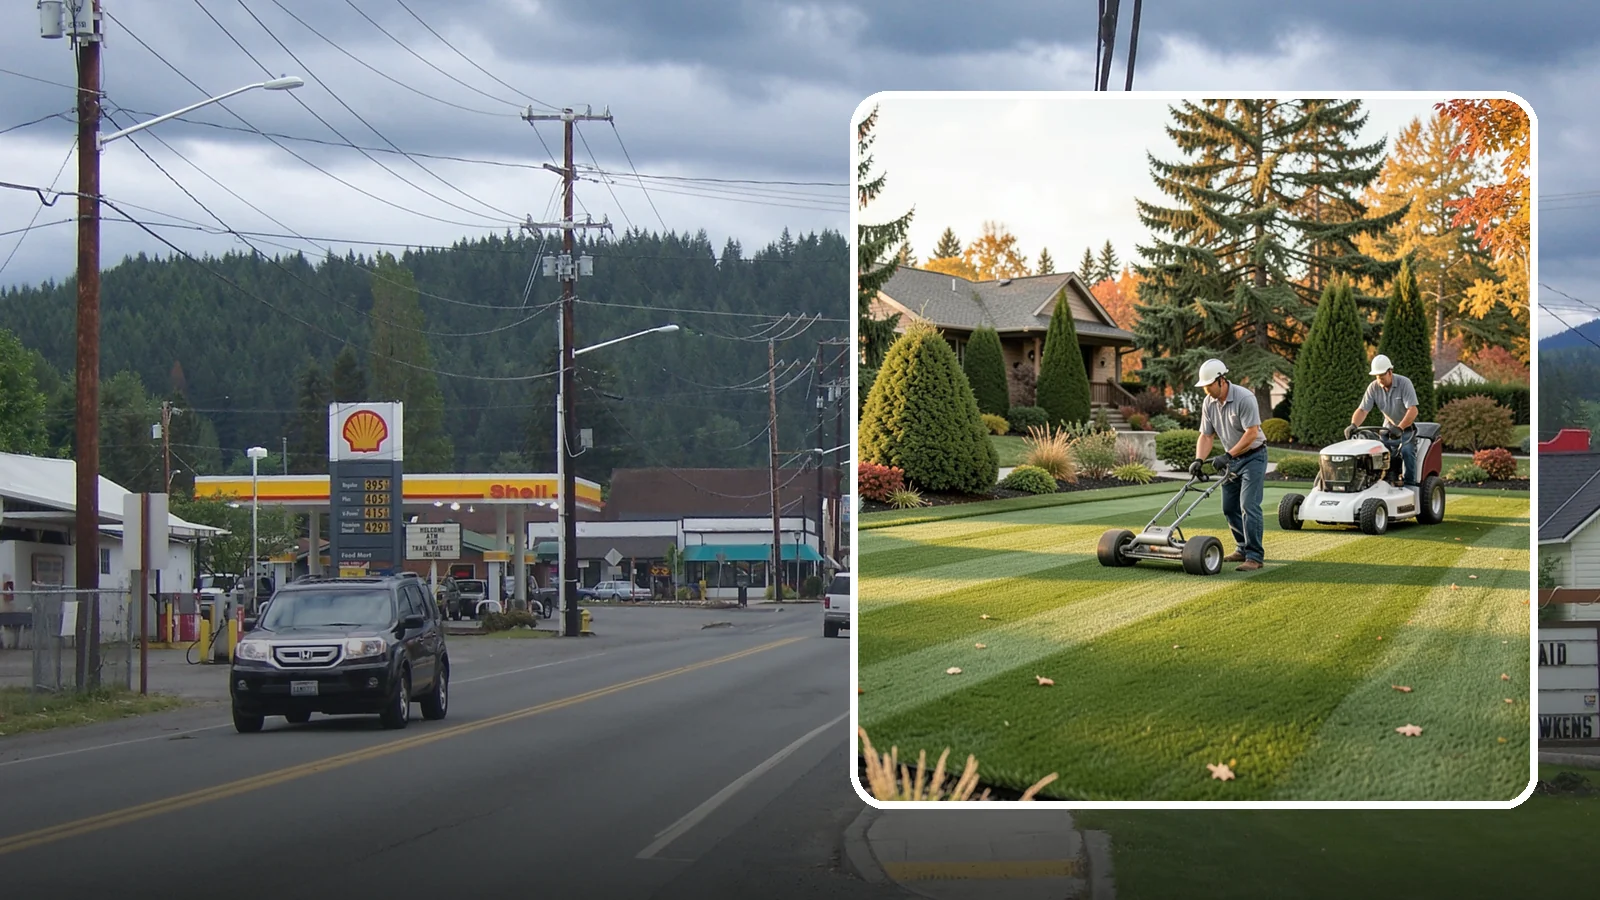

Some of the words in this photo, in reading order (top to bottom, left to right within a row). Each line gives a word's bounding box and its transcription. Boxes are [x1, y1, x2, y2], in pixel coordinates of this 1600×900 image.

[366, 480, 384, 490] 395
[490, 484, 547, 499] Shell
[366, 494, 384, 504] 405
[366, 508, 384, 518] 415
[366, 522, 384, 533] 429
[1539, 643, 1567, 666] AID
